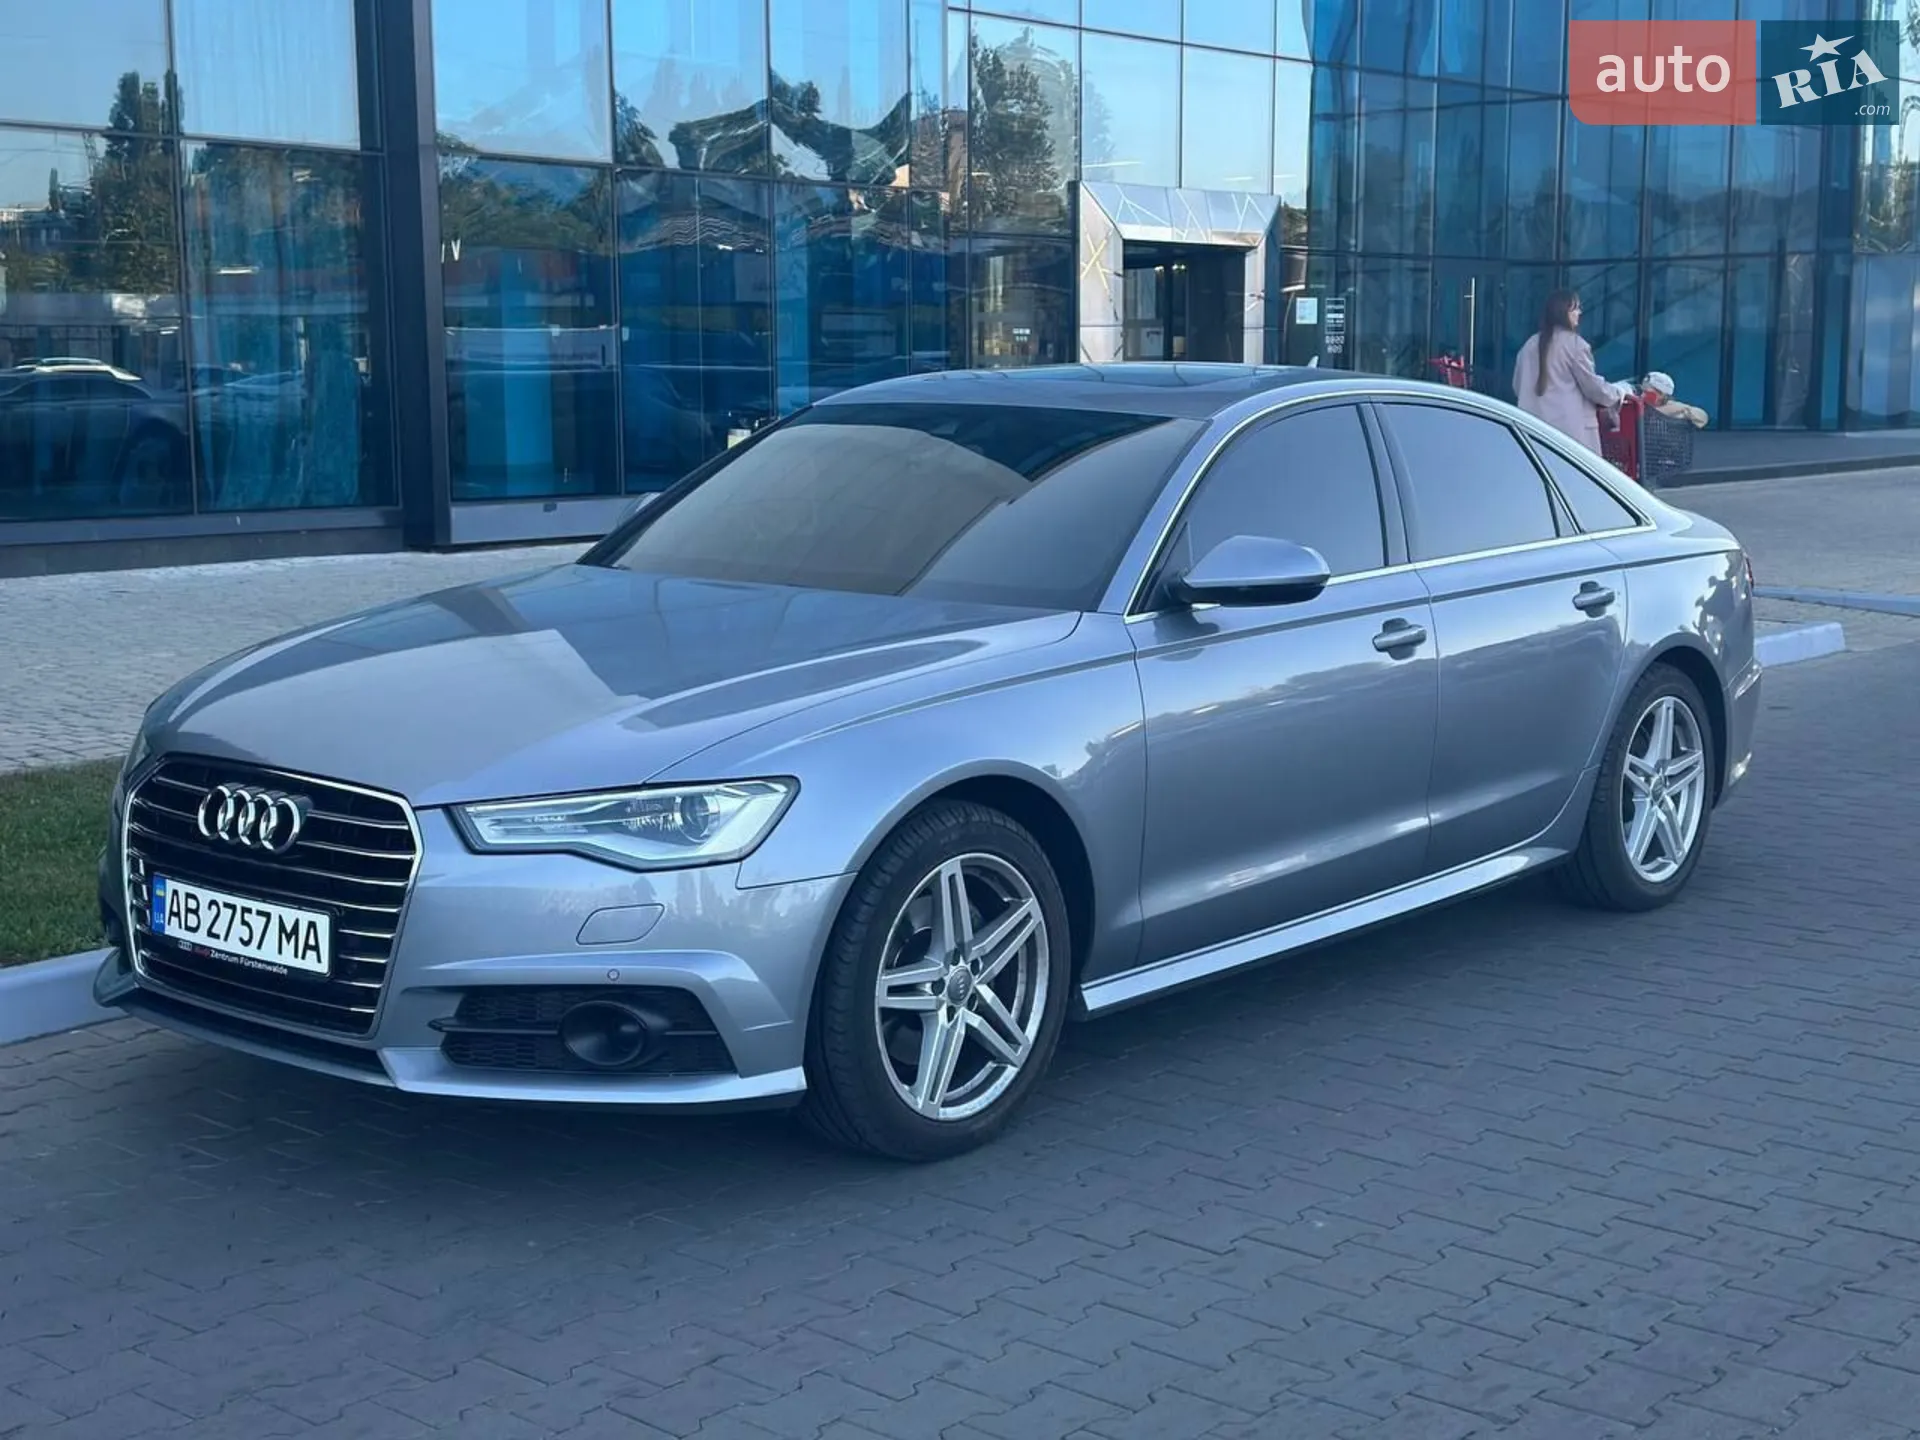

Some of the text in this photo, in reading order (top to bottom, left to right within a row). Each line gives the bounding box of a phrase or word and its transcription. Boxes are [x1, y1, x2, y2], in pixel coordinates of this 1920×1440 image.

[167, 889, 322, 964] AB 2757 MA
[210, 949, 239, 964] Zentrum
